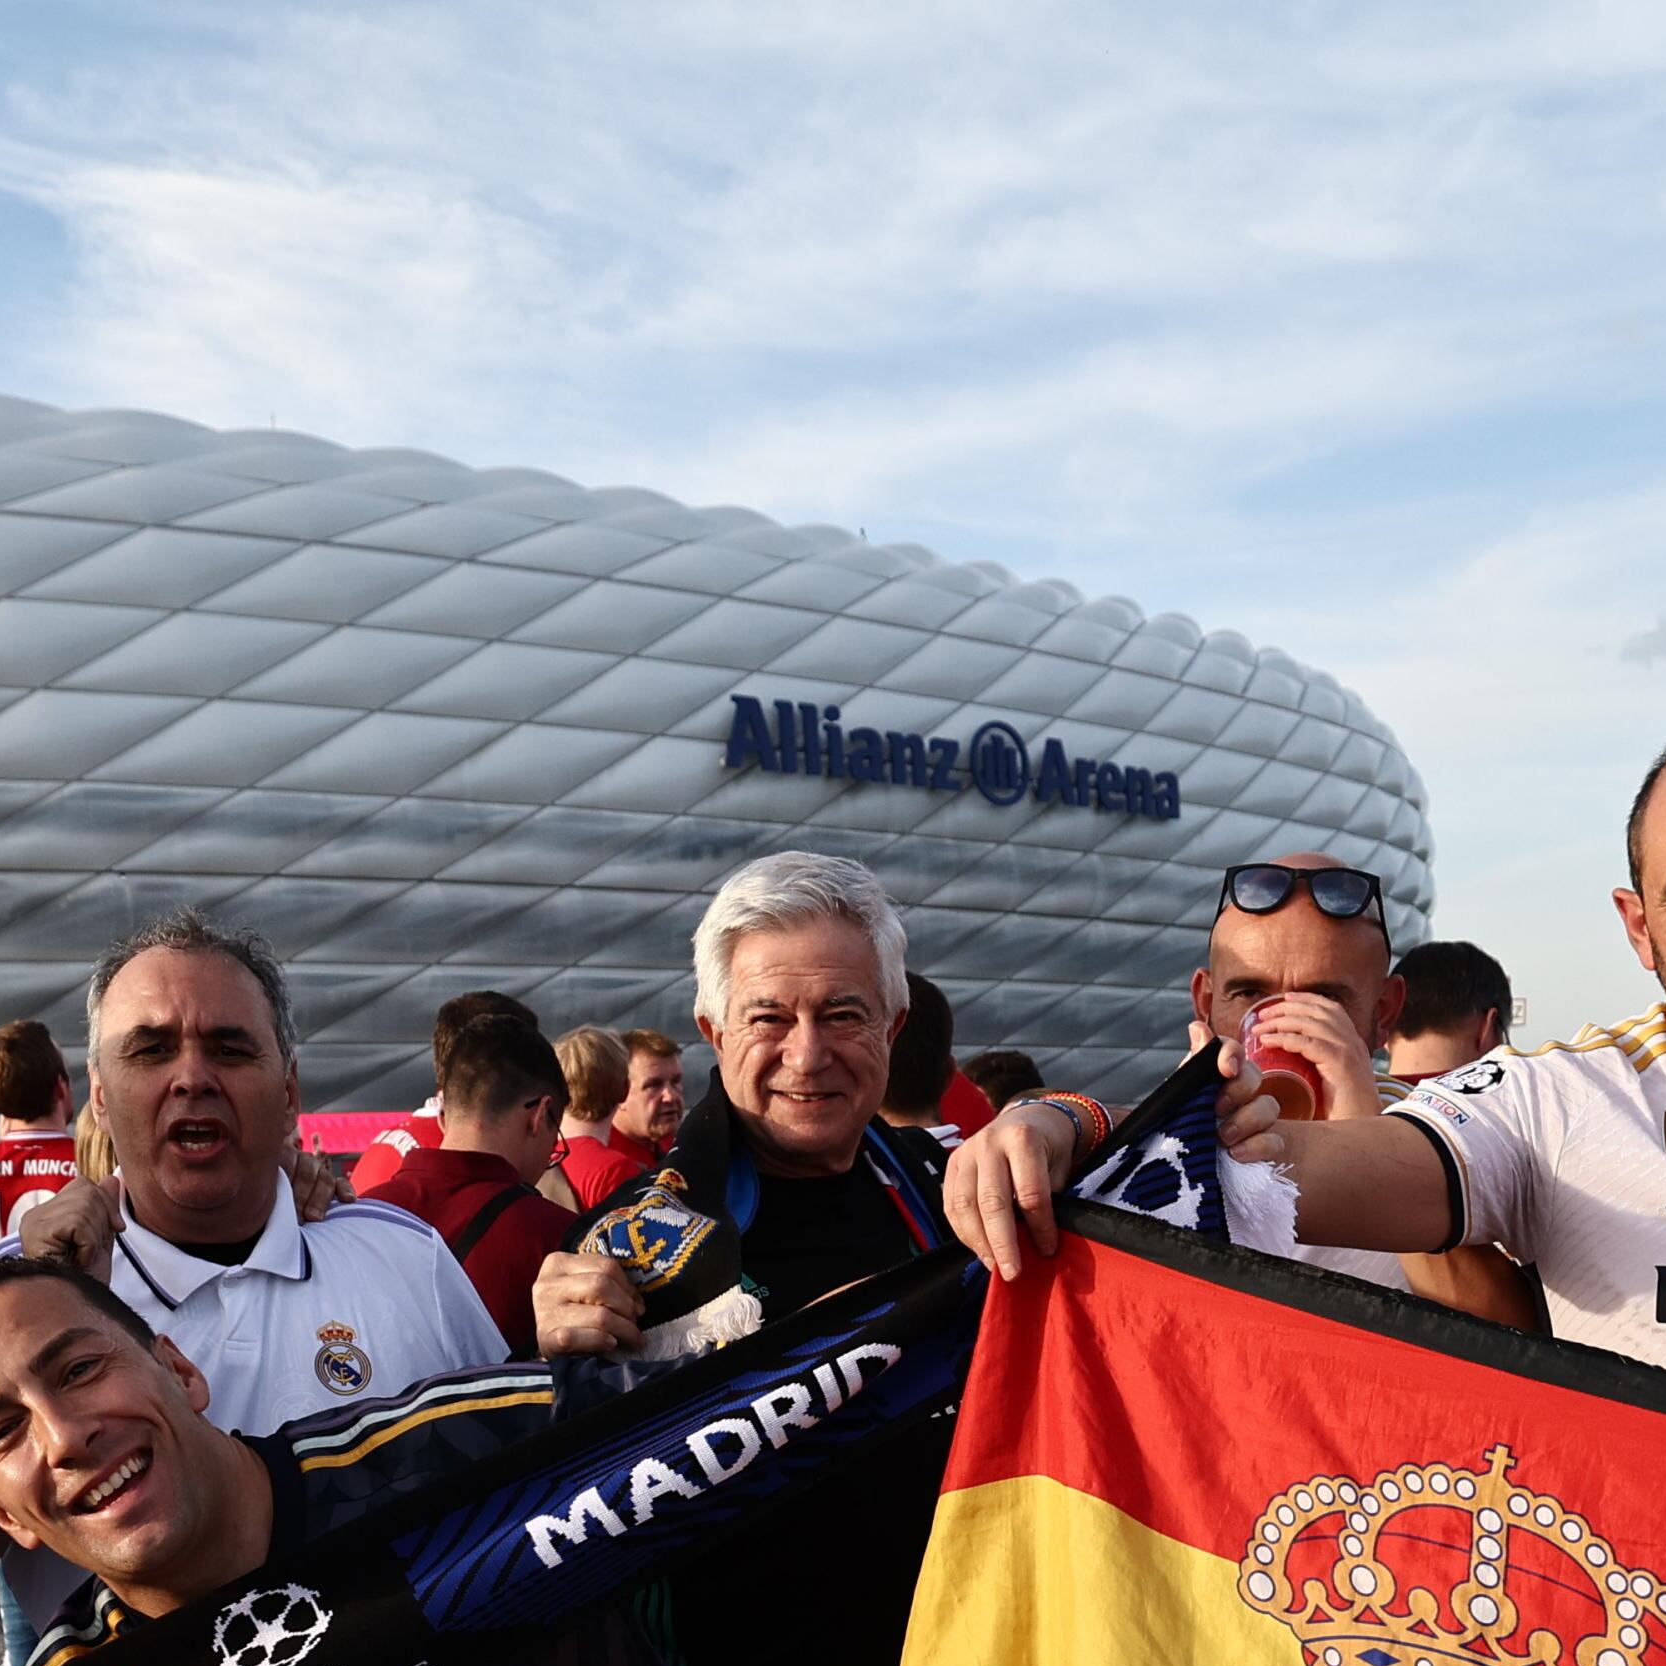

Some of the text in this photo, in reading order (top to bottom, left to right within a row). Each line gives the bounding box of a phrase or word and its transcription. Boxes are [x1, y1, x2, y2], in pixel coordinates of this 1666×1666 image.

[725, 694, 1181, 819] Allianz Arena
[23, 1158, 78, 1176] MÜNCH
